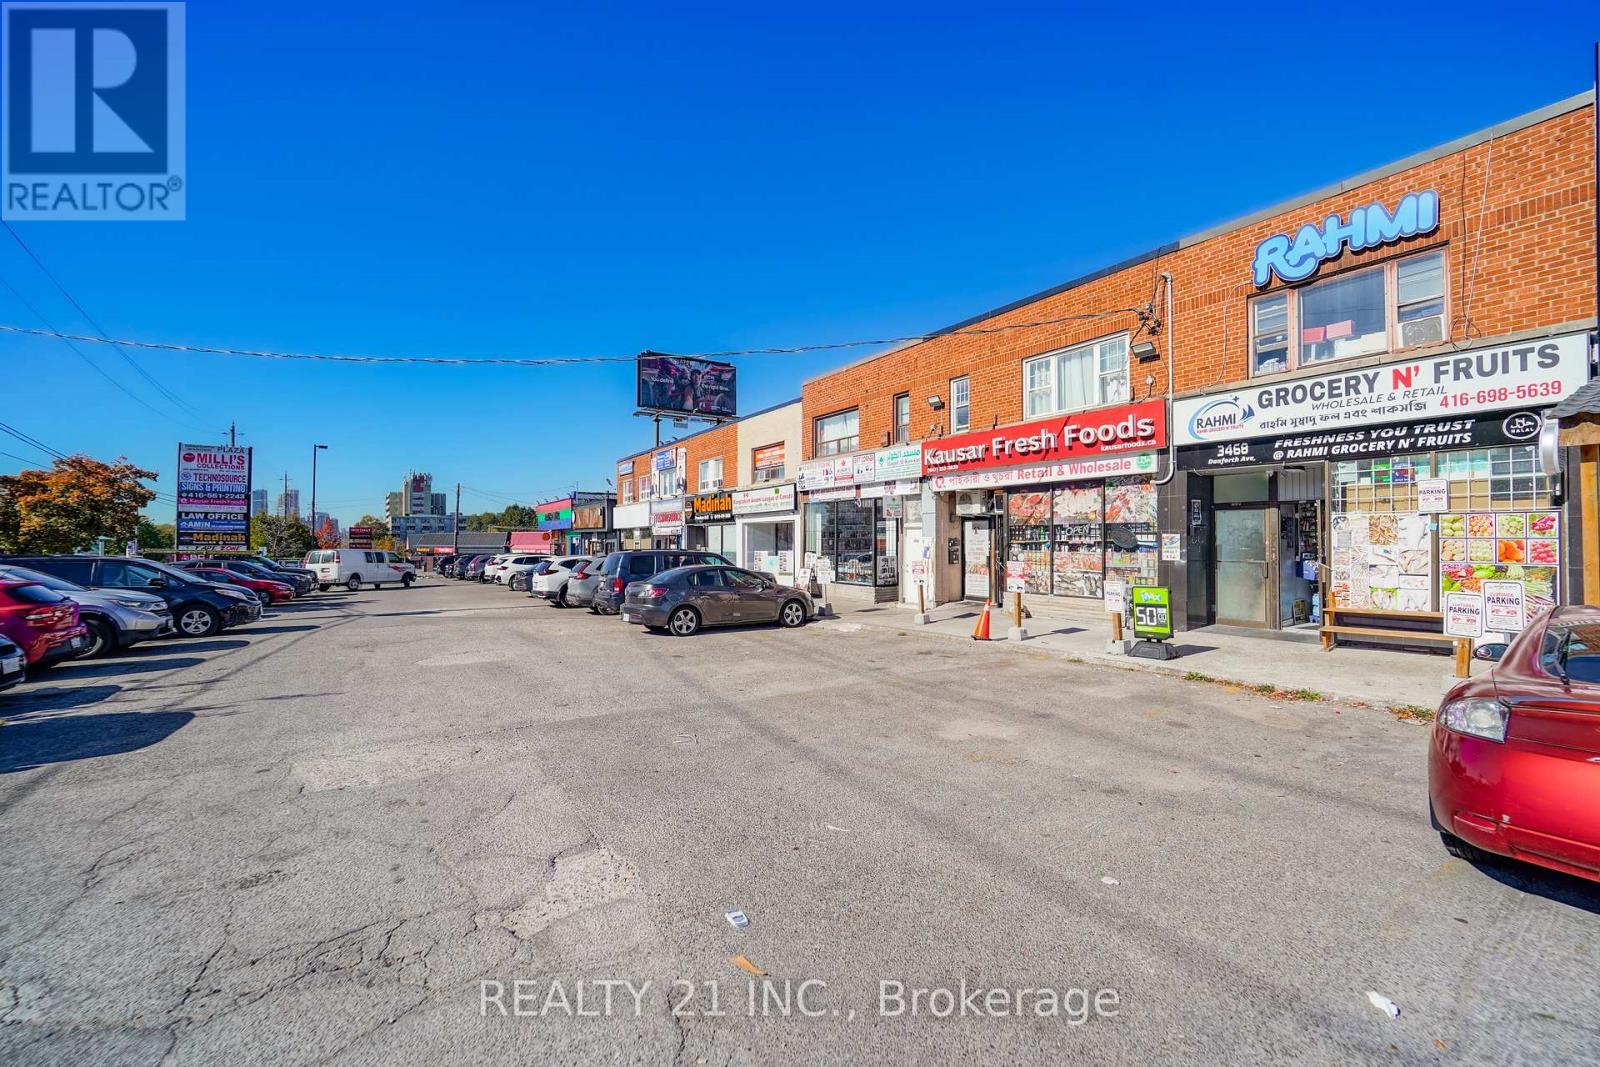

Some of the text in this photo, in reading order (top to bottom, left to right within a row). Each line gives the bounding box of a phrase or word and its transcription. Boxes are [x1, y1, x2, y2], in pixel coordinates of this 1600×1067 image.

[1251, 189, 1440, 287] RAHMI
[1258, 344, 1560, 409] GROCERY N' FRUITS
[1312, 386, 1447, 411] WHOLESALE & RETAIL
[1440, 380, 1562, 408] 416-698-5639
[1196, 413, 1236, 430] RAHMI
[924, 414, 1156, 466] Kausar Fresh Foods
[1274, 419, 1476, 449] FRESHNESS YOU TRUST
[217, 445, 245, 454] PLAZA
[1101, 440, 1157, 451] kausarfoods.ca
[1217, 442, 1249, 457] 3468
[1272, 451, 1284, 460] @
[1286, 445, 1328, 459] RAHMI
[1331, 439, 1397, 455] GROCERY
[1417, 432, 1473, 448] FRUITS
[197, 453, 245, 466] MILLI'S
[194, 473, 246, 483] TECHNOSOURCE
[1017, 465, 1053, 480] Retail
[1057, 464, 1065, 476] &
[1069, 459, 1132, 475] Wholesale
[181, 482, 246, 493] SIGNS & PRINTING
[694, 493, 732, 513] Madinah
[192, 533, 246, 541] Madinah
[1066, 525, 1089, 536] OPEN
[1487, 596, 1520, 606] PARKING
[1136, 606, 1157, 626] 50
[1449, 606, 1480, 615] PARKING
